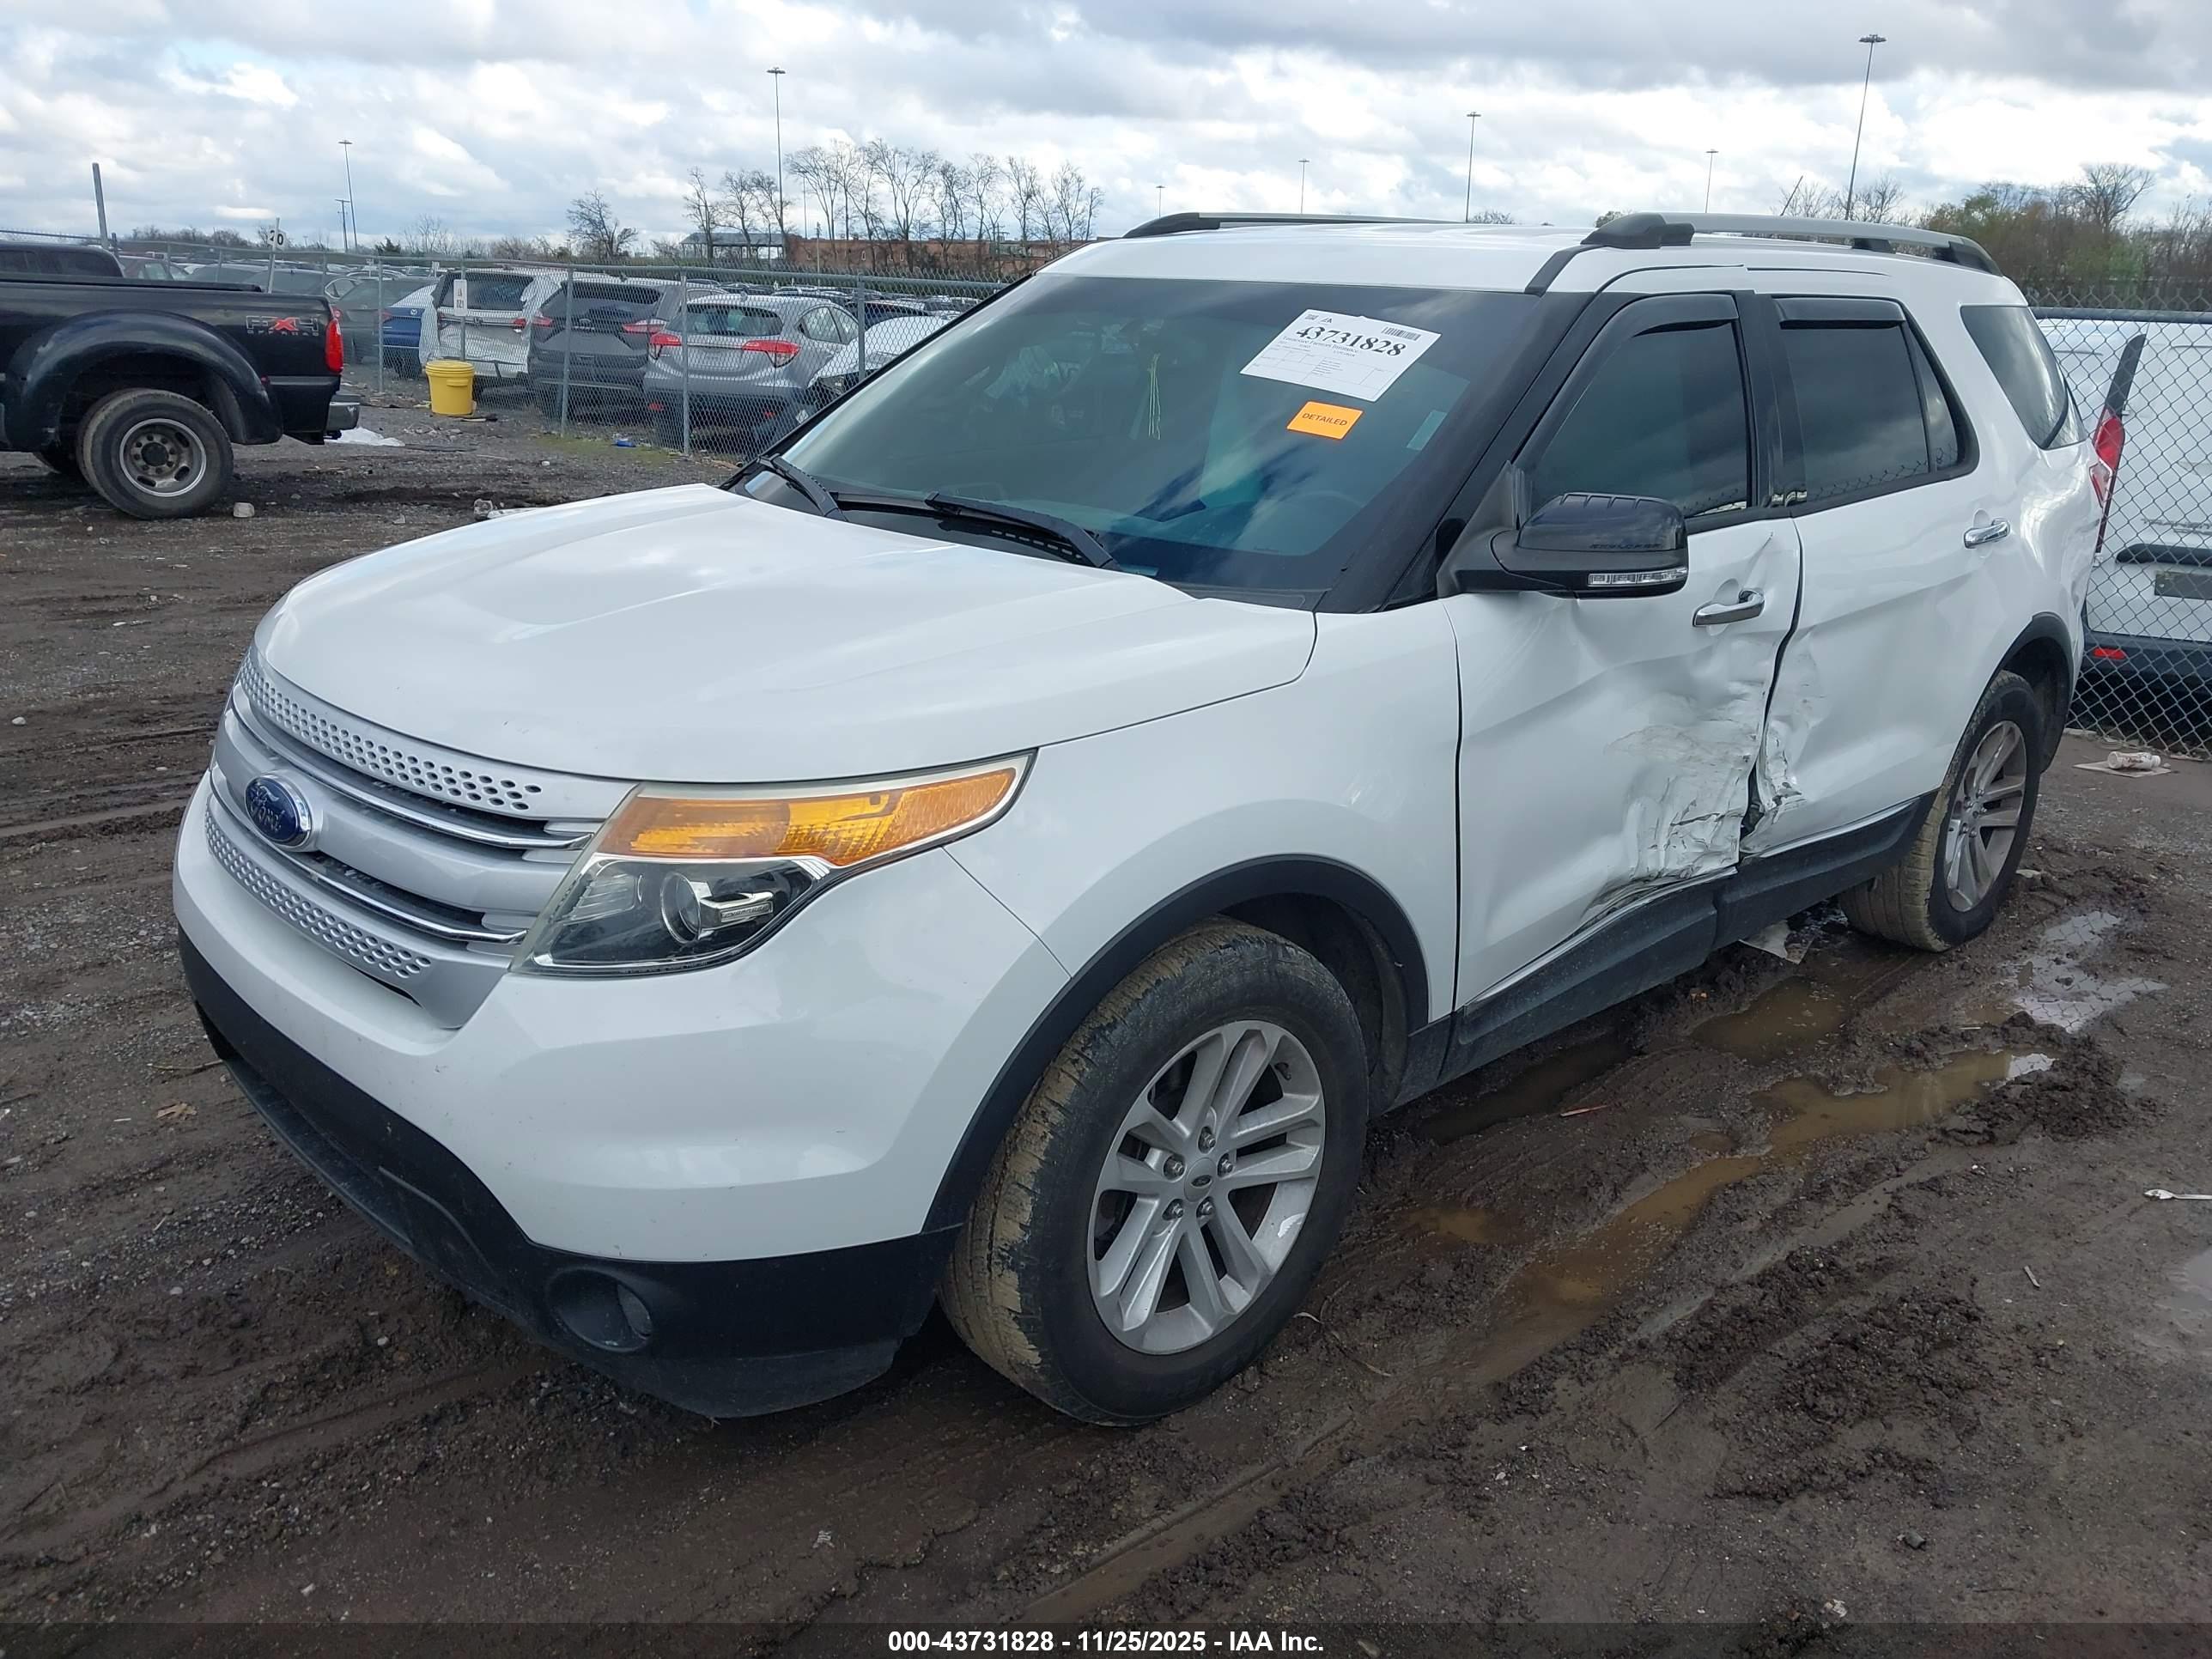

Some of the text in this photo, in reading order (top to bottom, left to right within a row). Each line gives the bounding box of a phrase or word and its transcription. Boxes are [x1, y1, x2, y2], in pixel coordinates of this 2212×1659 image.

[246, 315, 319, 331] FX4
[1296, 325, 1407, 356] 43731828
[1302, 412, 1348, 427] DETAILED
